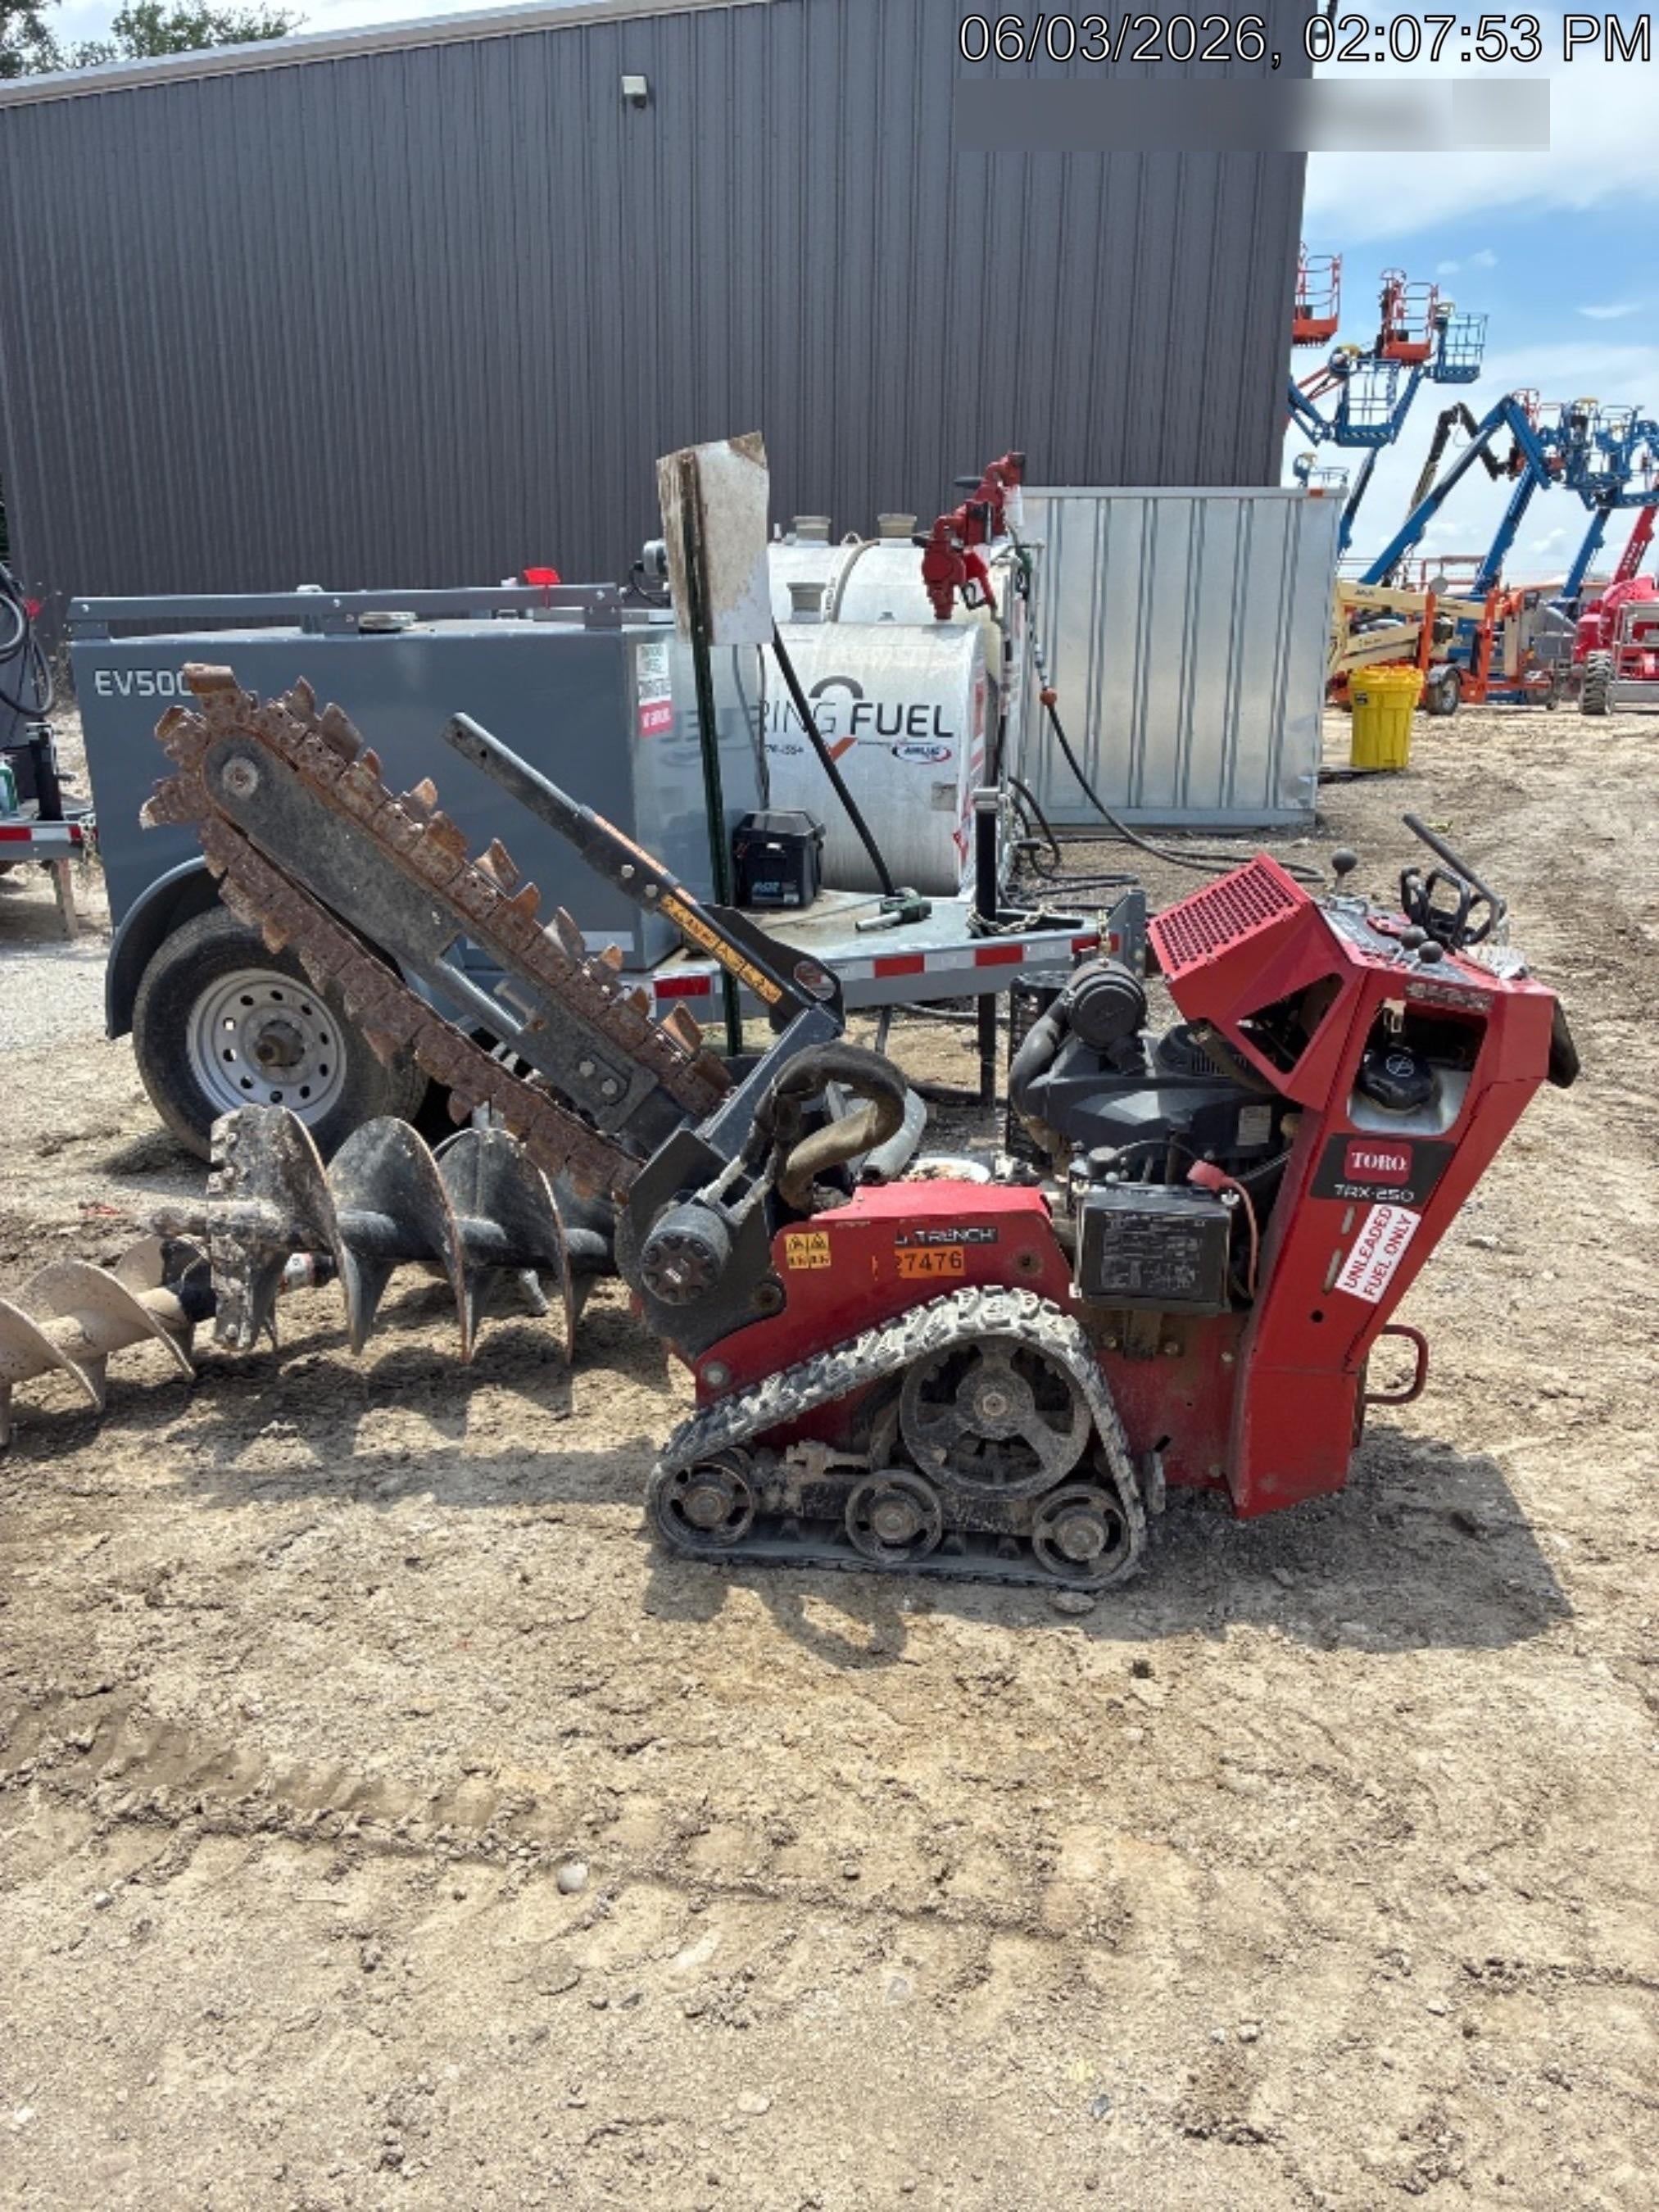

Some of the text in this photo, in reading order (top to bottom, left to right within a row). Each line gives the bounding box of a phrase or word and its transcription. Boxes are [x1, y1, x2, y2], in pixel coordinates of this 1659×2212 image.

[850, 702, 954, 737] FUEL
[1352, 1152, 1407, 1172] TORO
[1334, 1184, 1415, 1203] TRX-250
[1344, 1206, 1393, 1289] UNLEADED
[1363, 1213, 1413, 1296] FUEL ONLY
